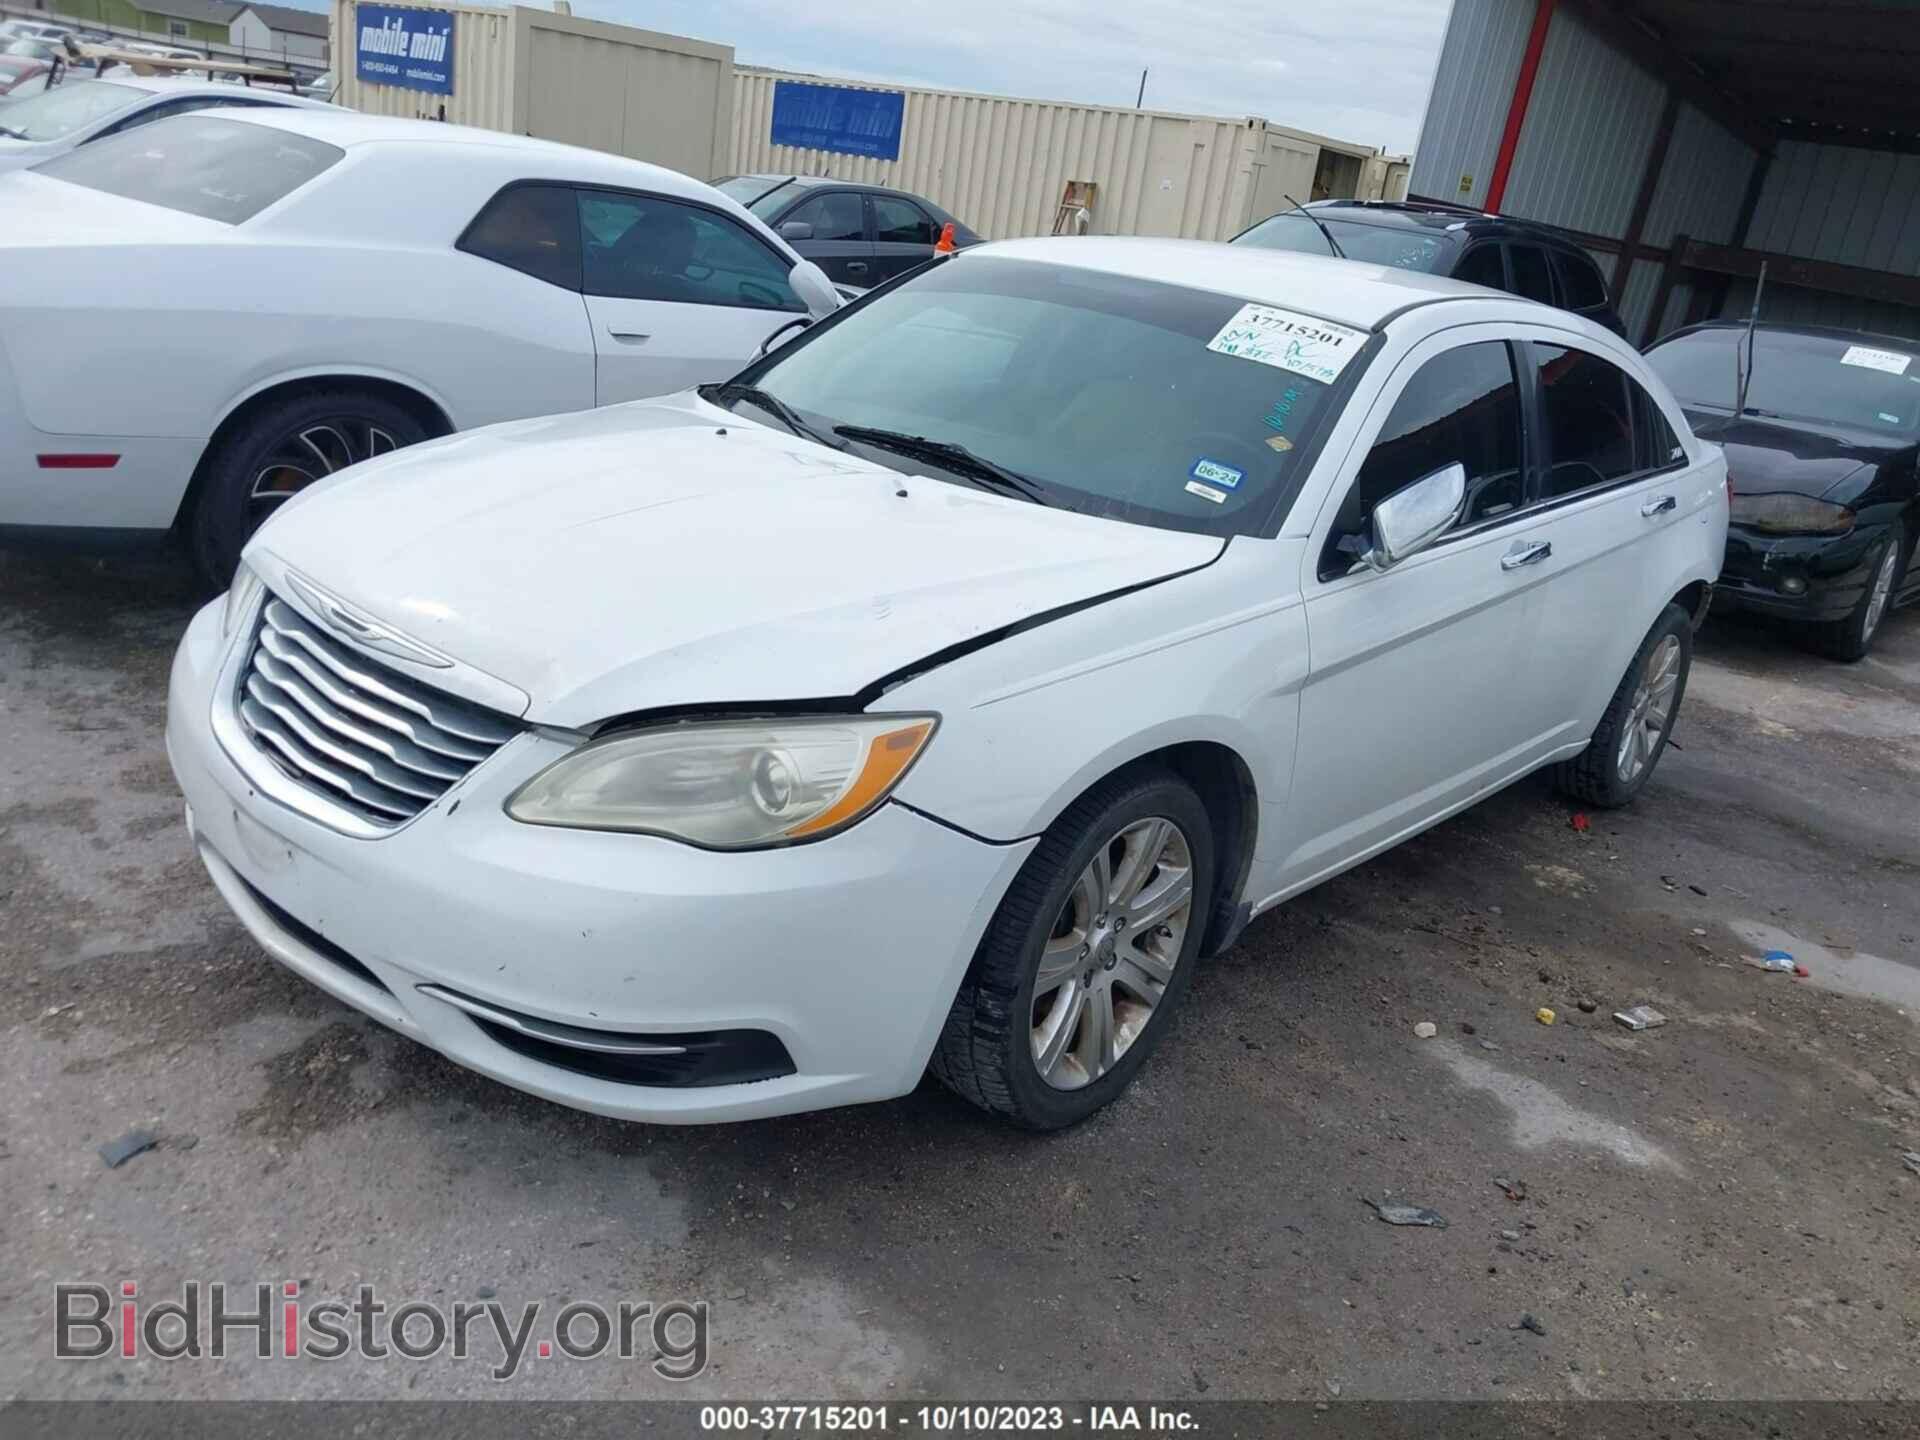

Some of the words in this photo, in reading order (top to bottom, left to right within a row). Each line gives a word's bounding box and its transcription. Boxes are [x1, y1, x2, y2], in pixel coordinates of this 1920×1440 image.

[360, 16, 409, 57] mobile
[409, 26, 447, 62] mini
[1245, 313, 1343, 347] 37715201
